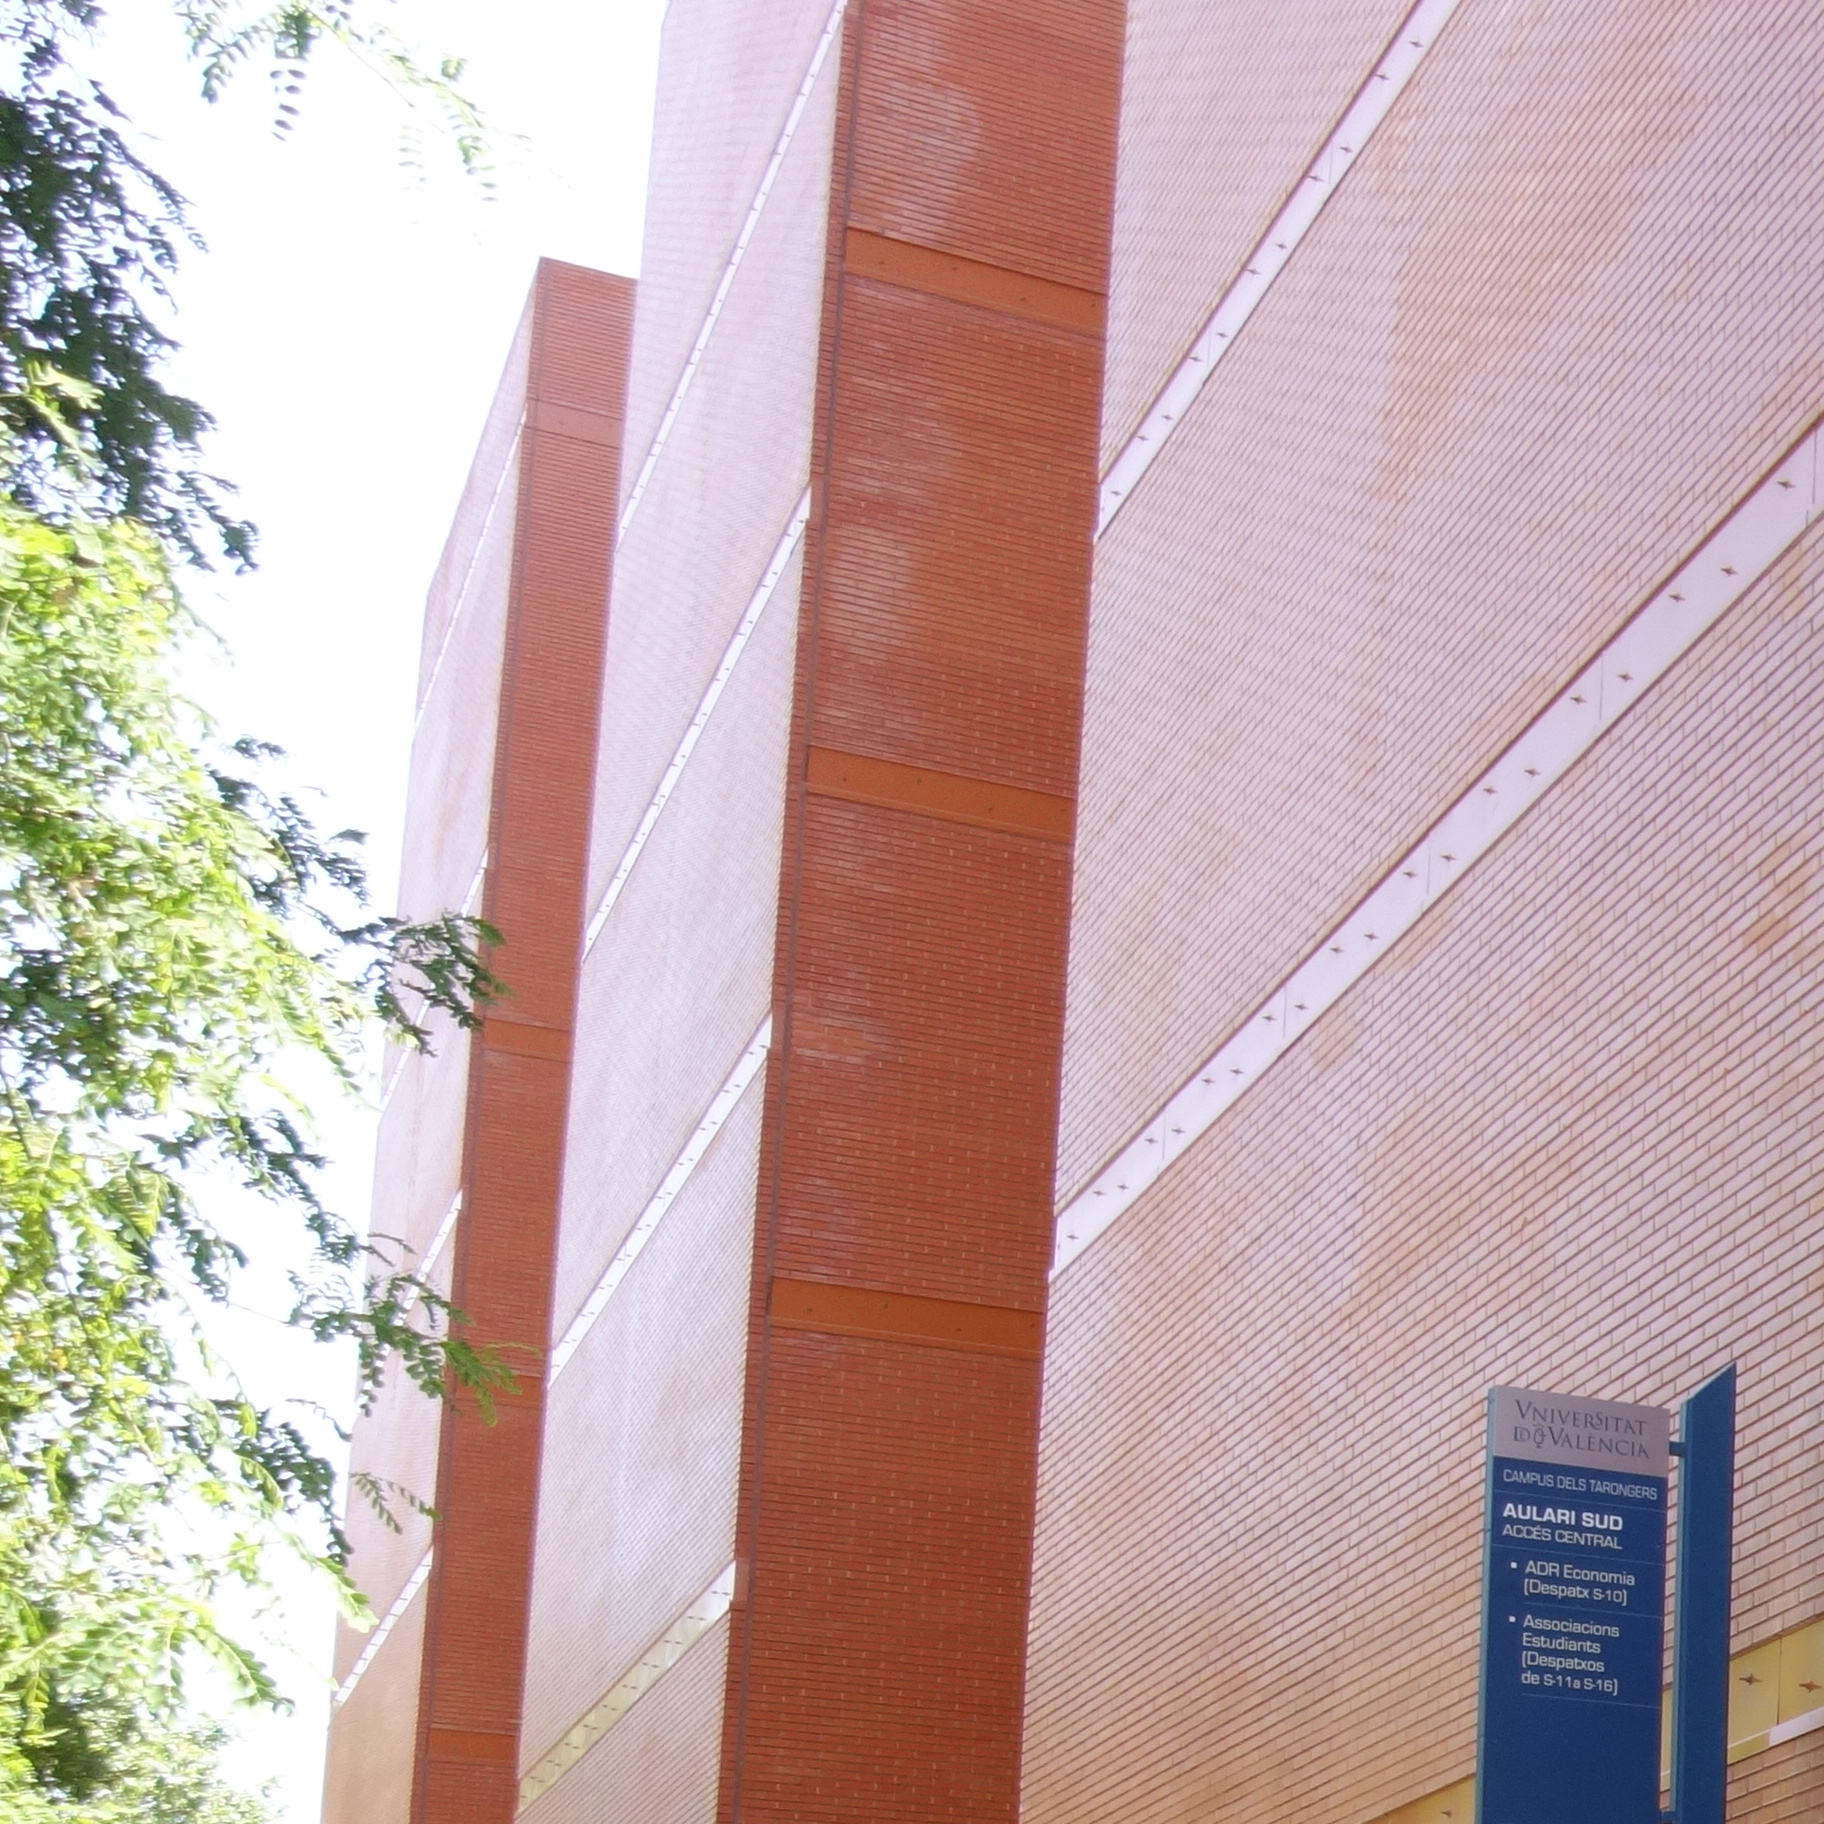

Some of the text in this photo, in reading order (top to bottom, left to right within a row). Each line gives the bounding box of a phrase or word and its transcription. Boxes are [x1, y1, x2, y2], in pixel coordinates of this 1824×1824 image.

[1502, 1468, 1658, 1501] CAMPUS DELS TARONGERS
[1502, 1502, 1624, 1532] AULARI SUD
[1501, 1523, 1623, 1550] ACCÉS CENTRAL
[1524, 1560, 1636, 1587] ADR Economia
[1523, 1577, 1628, 1607] (Despatx S-10)
[1522, 1613, 1621, 1638] Associacions
[1521, 1631, 1602, 1654] Estudiants
[1521, 1650, 1605, 1673] (Despatxos
[1520, 1670, 1541, 1685] de
